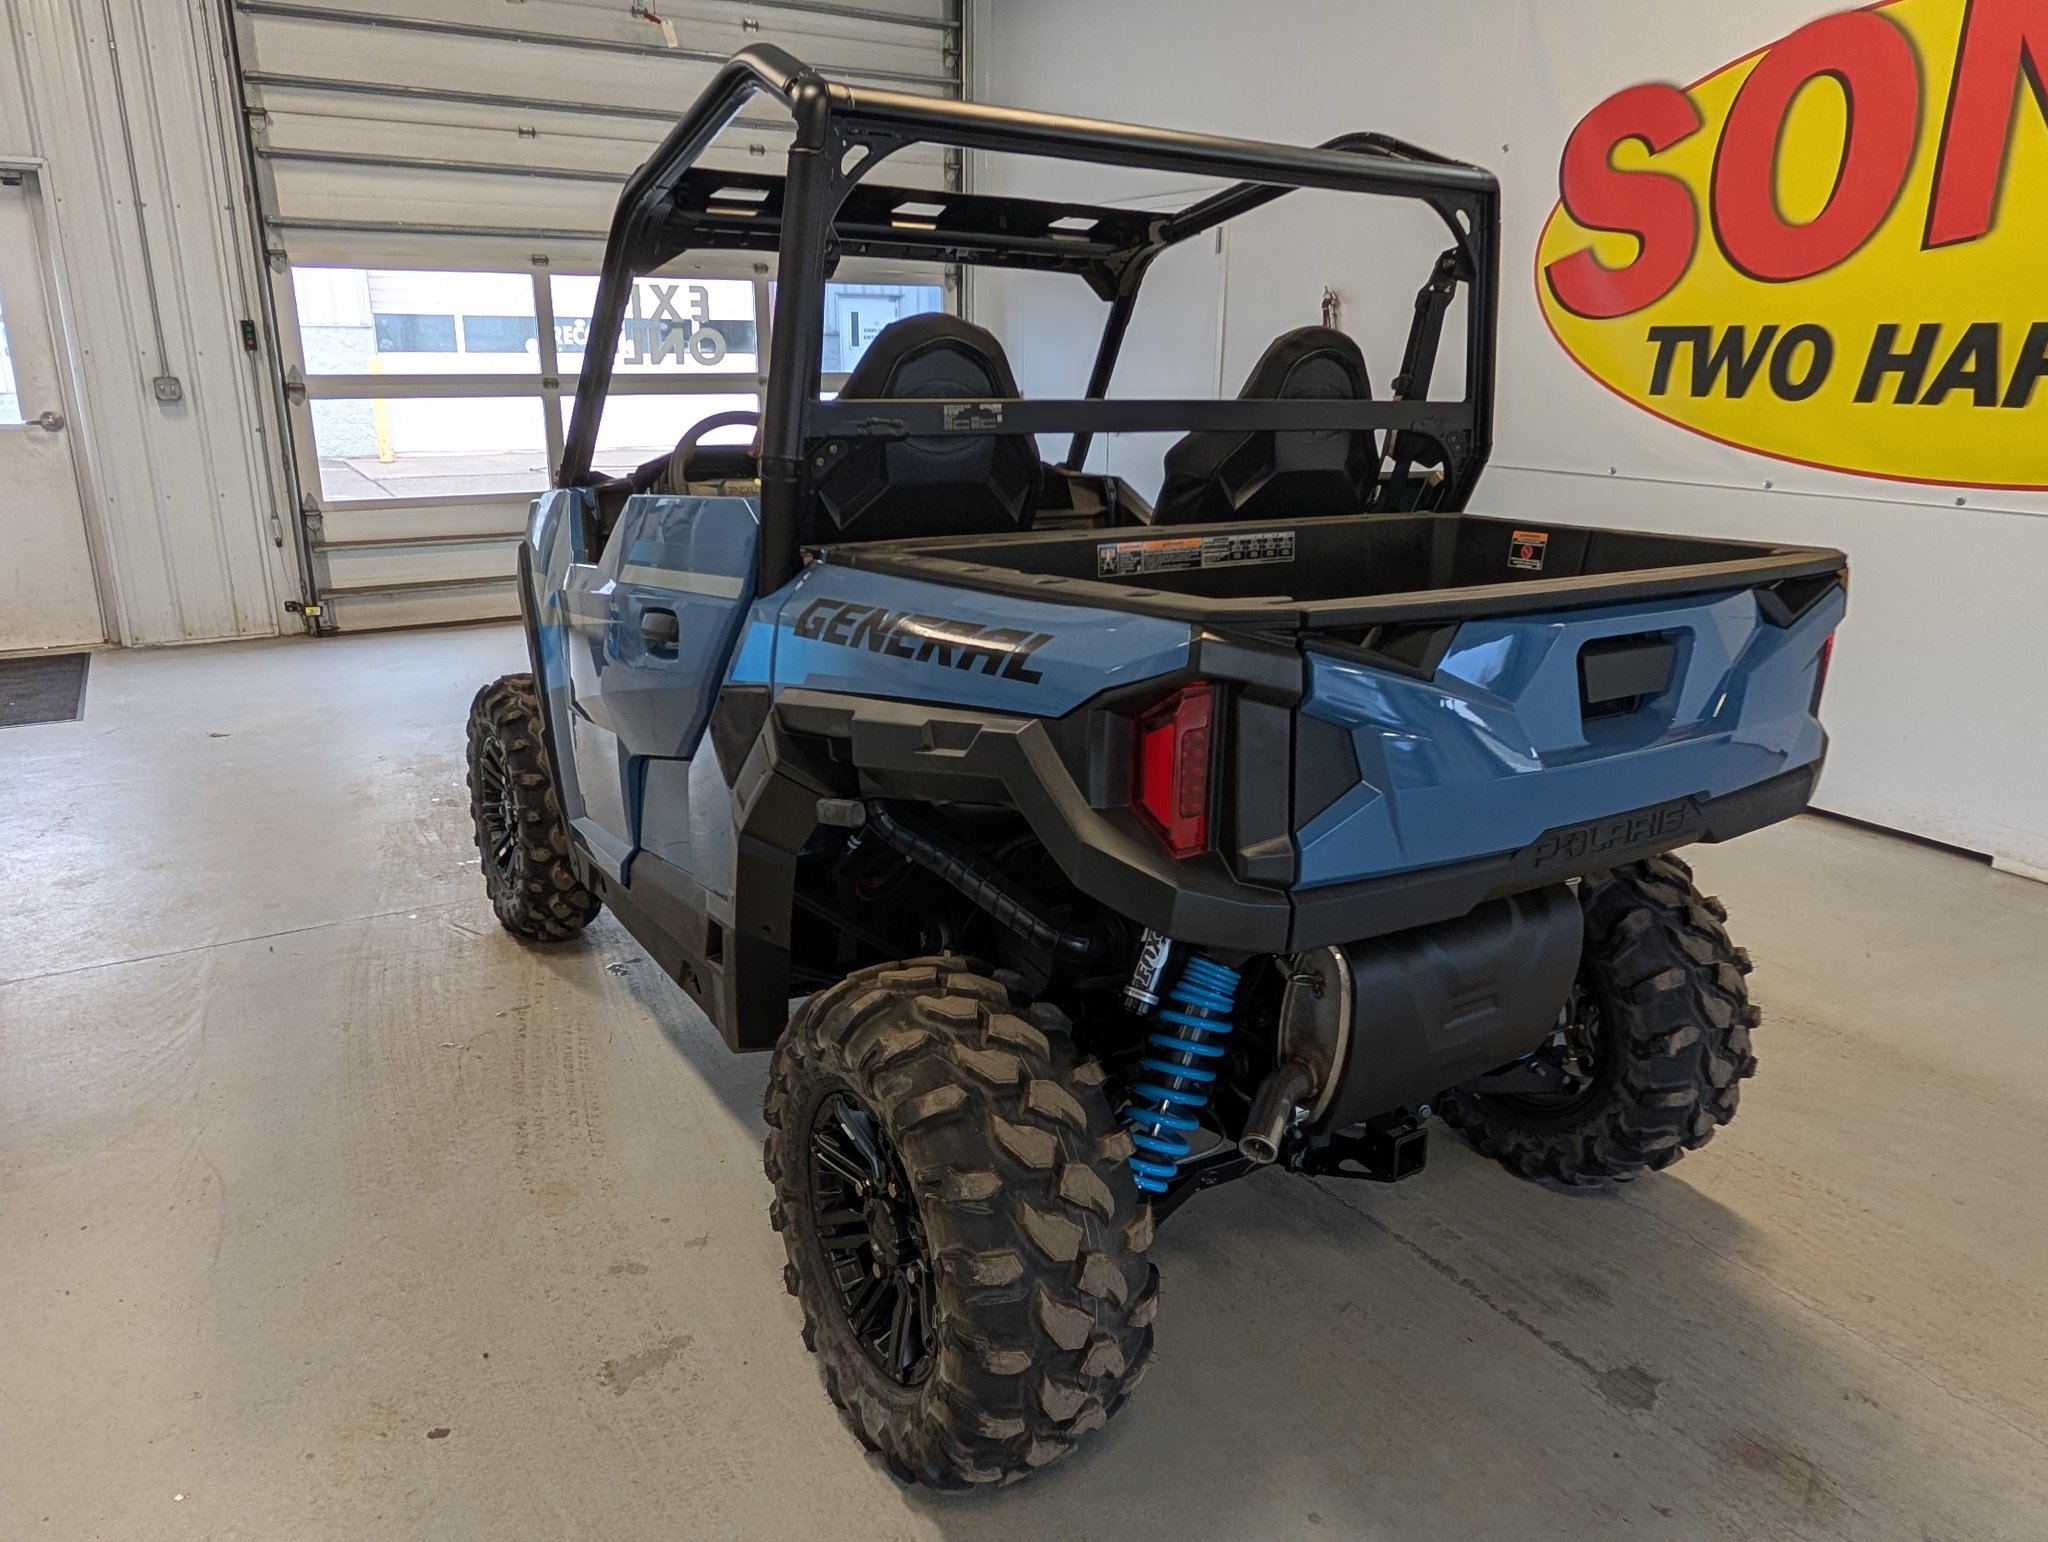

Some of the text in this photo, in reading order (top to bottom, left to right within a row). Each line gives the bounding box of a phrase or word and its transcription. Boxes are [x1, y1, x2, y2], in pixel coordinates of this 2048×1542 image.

[1646, 323, 1833, 401] TWO
[793, 598, 1055, 685] GENERAL
[1534, 801, 1689, 868] POLARIS
[1132, 929, 1170, 988] FOX
